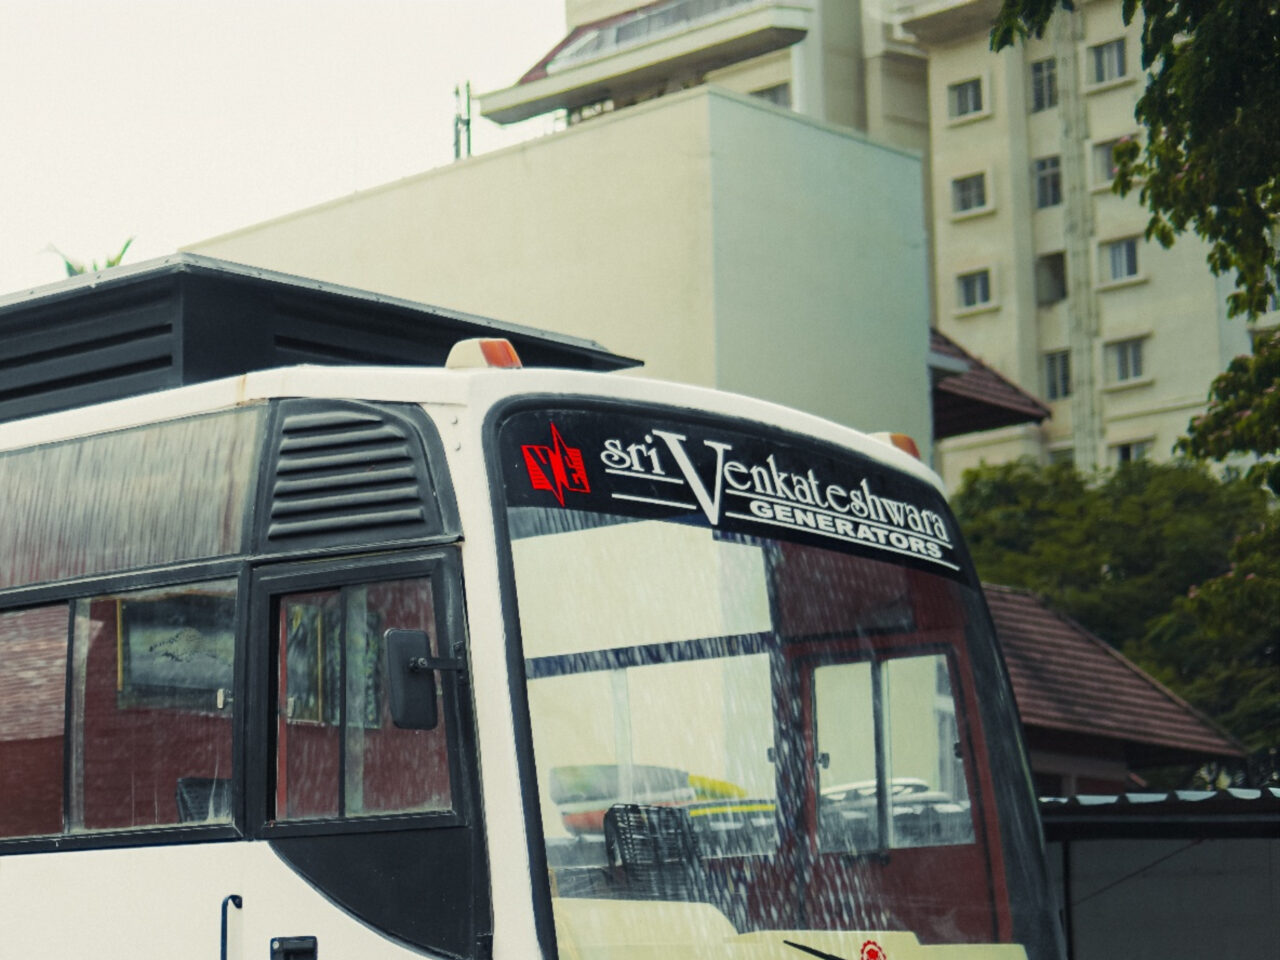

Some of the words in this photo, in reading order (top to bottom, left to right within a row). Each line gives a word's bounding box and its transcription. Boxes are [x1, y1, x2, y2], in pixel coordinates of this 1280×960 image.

[600, 434, 666, 475] sri
[652, 429, 949, 542] Venkateshwara
[749, 501, 942, 559] GENERATORS
